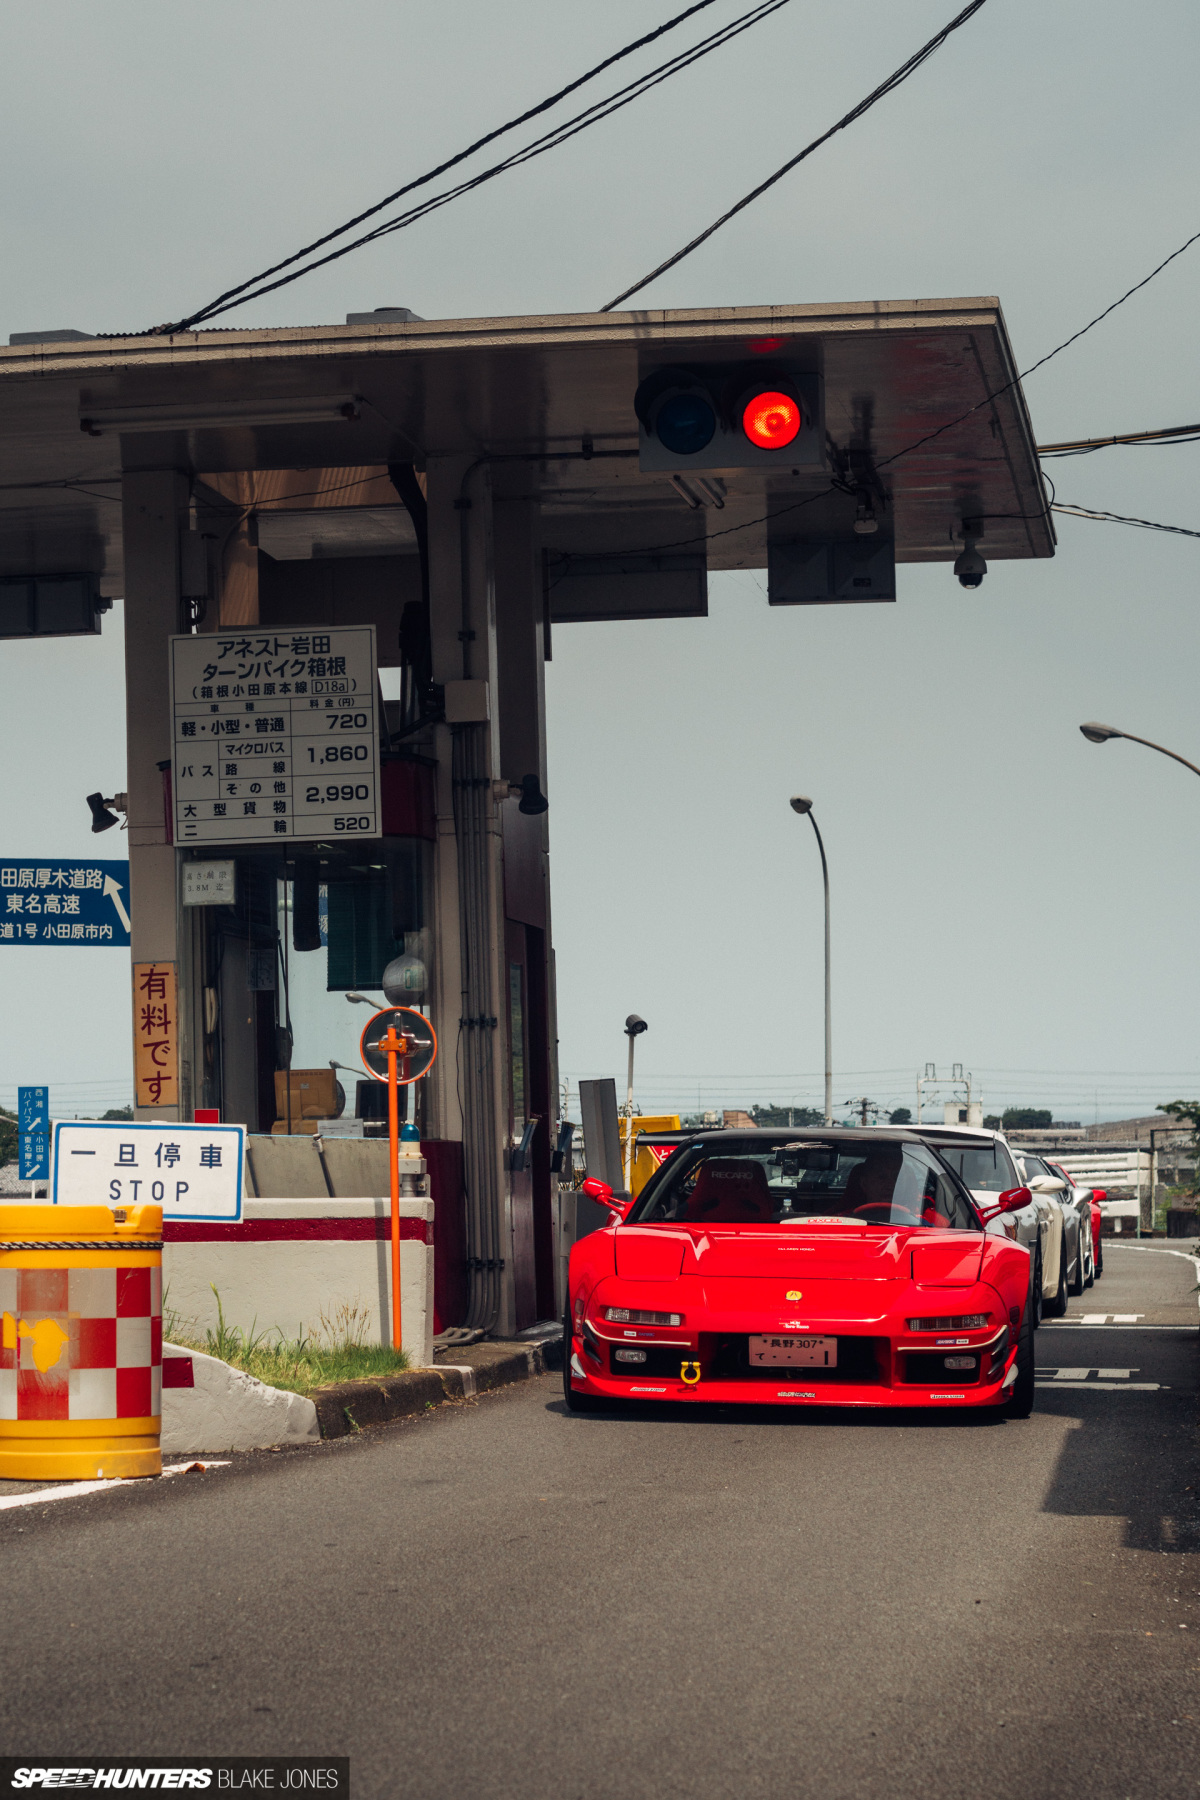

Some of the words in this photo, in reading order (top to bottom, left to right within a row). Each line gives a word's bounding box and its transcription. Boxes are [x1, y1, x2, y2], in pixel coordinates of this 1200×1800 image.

[217, 635, 331, 659] アネスト岩田
[203, 656, 346, 682] ターンパイク箱根
[325, 713, 368, 729] 720
[225, 741, 285, 755] マイクロバス
[307, 745, 368, 764] 1,860
[181, 765, 214, 778] バス
[226, 781, 286, 795] その他
[306, 784, 369, 803] 2,990
[184, 800, 286, 817] 大型貨物
[334, 816, 370, 830] 520
[6, 893, 81, 914] 東名高速
[0, 922, 38, 938] 道1号
[42, 923, 113, 939] 小田原市内
[139, 968, 172, 1103] 有料です
[23, 1091, 32, 1123] バイパス
[35, 1136, 44, 1162] 小田原
[71, 1142, 223, 1169] 一旦停車
[711, 1171, 754, 1179] RECARO
[109, 1179, 190, 1202] STOP
